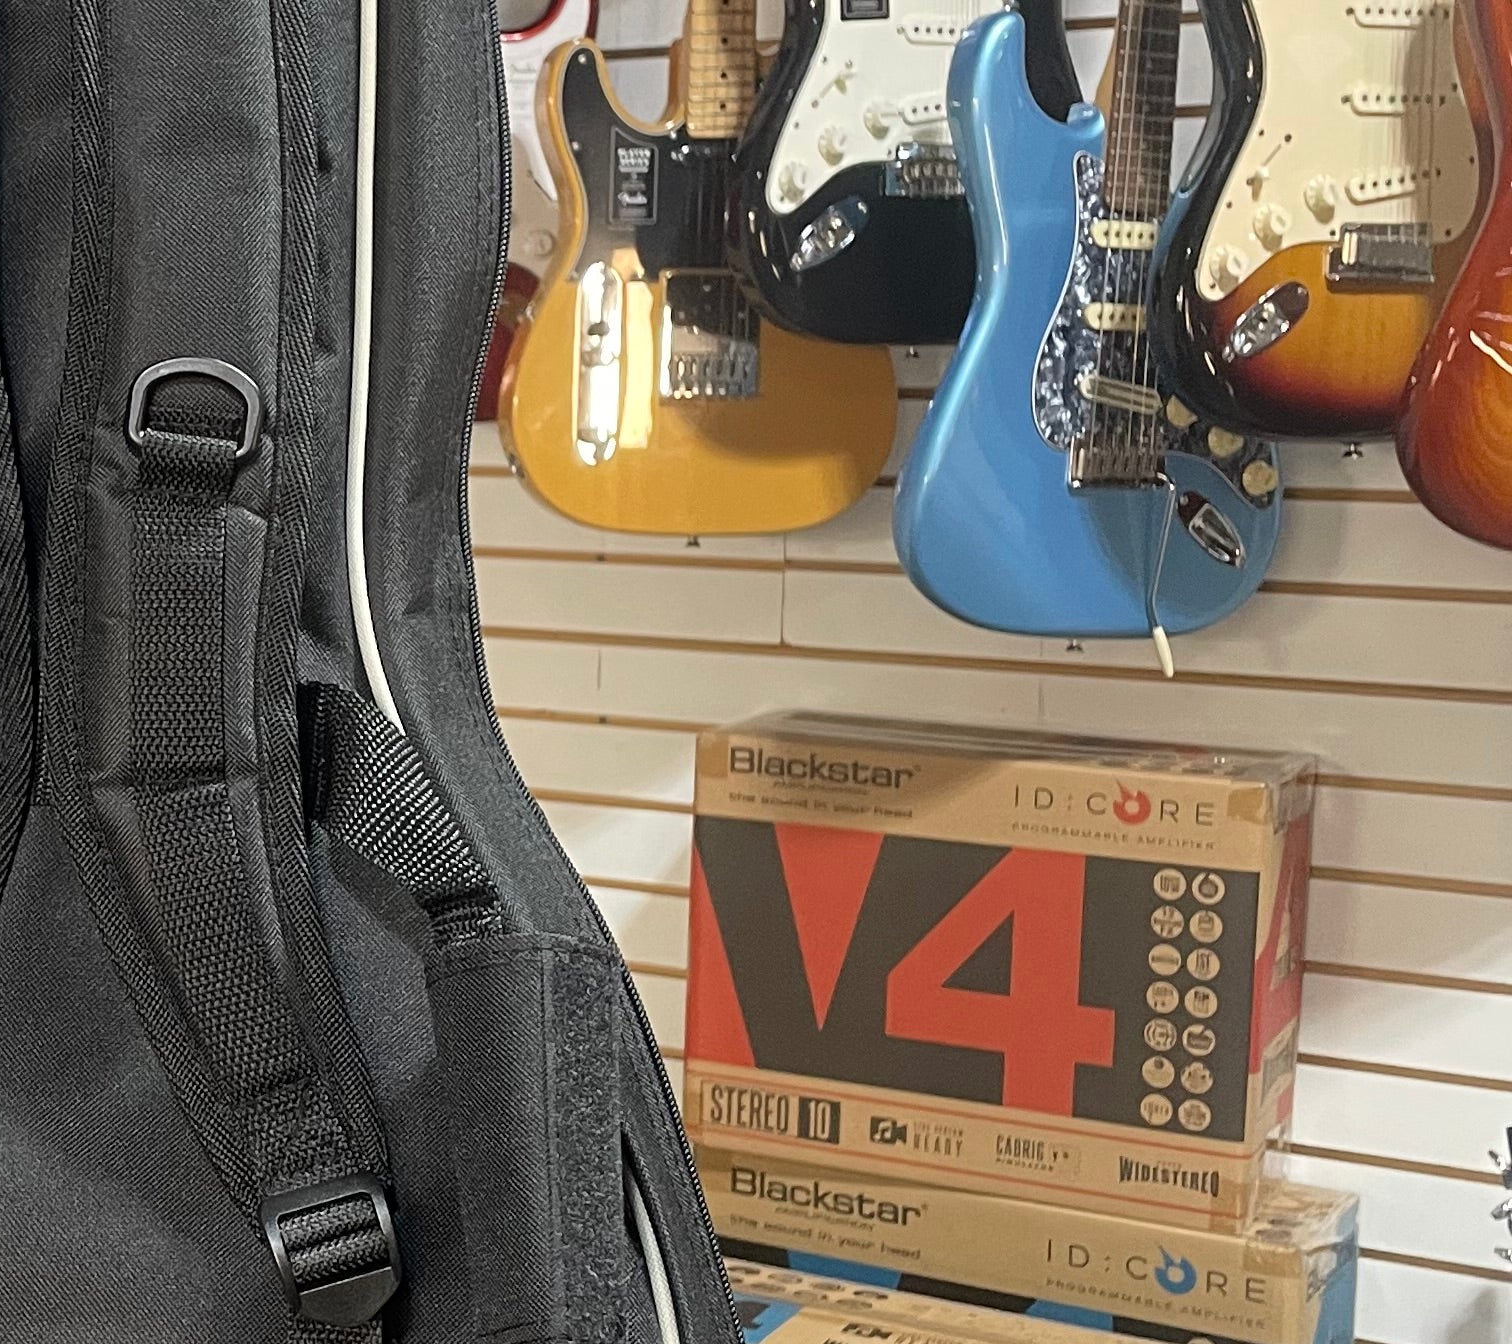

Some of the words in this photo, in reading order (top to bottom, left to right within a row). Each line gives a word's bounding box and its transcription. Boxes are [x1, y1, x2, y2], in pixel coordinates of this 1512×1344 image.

[730, 746, 915, 789] Blackstar
[711, 1083, 788, 1135] STEREO
[808, 1099, 831, 1142] 10
[731, 1166, 922, 1226] Blackstar
